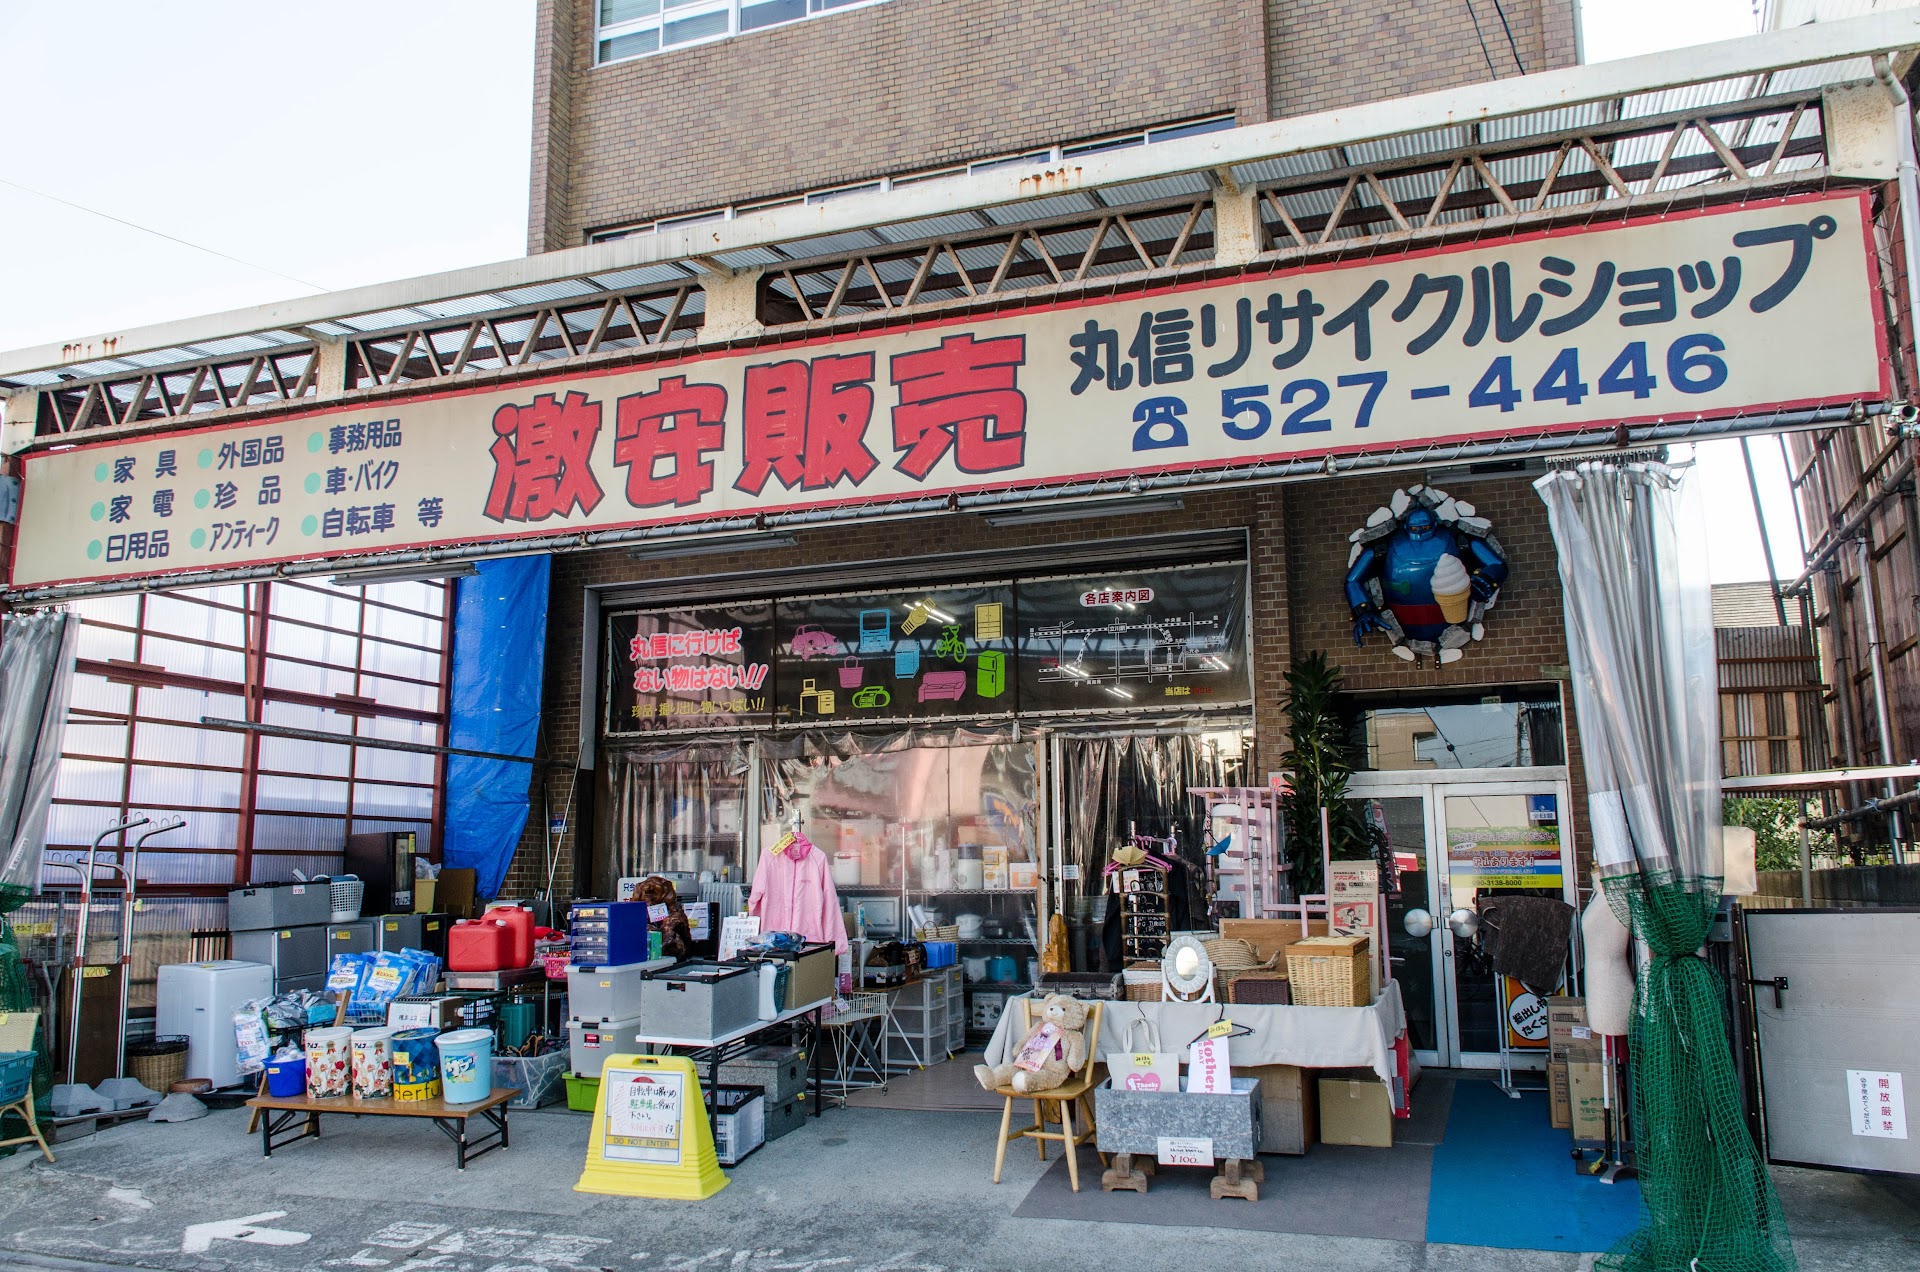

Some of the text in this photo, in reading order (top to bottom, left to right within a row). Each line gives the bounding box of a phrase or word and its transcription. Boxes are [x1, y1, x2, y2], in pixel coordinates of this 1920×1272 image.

[1070, 213, 1838, 396] 丸信リサイクルショップ
[1222, 332, 1729, 441] 527-4446
[328, 418, 402, 455] 事務用品
[483, 332, 1028, 524] 激安販売
[218, 435, 284, 471] 外国品
[326, 459, 400, 495] 車・バイク
[105, 529, 169, 562] 日用品
[208, 516, 281, 552] アンティーク
[1085, 589, 1150, 605] 各店案内図
[630, 627, 743, 661] 丸信に行けば
[1164, 686, 1191, 696] 当店は
[1521, 1014, 1548, 1037] たくさ
[1878, 1078, 1893, 1131] 開放厳禁
[613, 1137, 670, 1147] DO NOT ENTER
